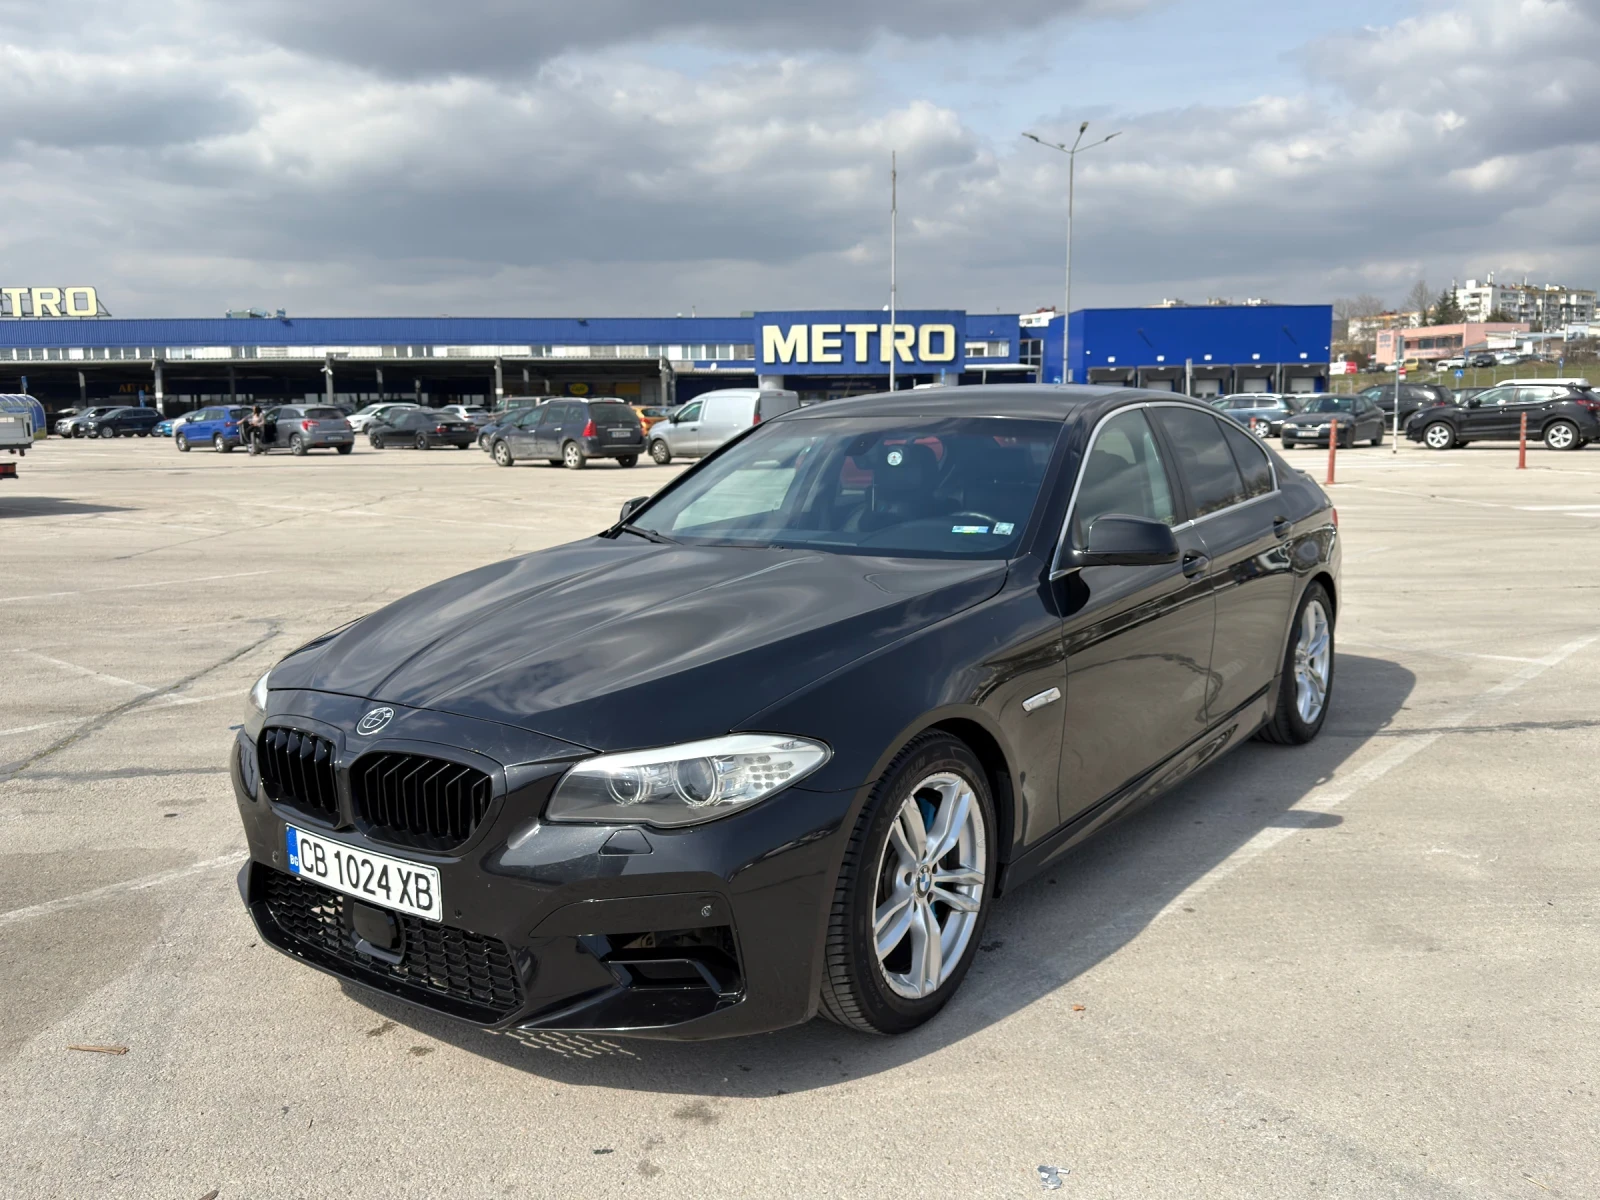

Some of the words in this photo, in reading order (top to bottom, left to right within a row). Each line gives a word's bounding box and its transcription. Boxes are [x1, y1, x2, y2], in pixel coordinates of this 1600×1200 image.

[0, 286, 98, 317] TRO
[762, 323, 955, 363] METRO
[289, 854, 299, 867] BG
[300, 838, 328, 878] CB
[334, 850, 392, 900] 1024
[397, 867, 433, 911] XB
